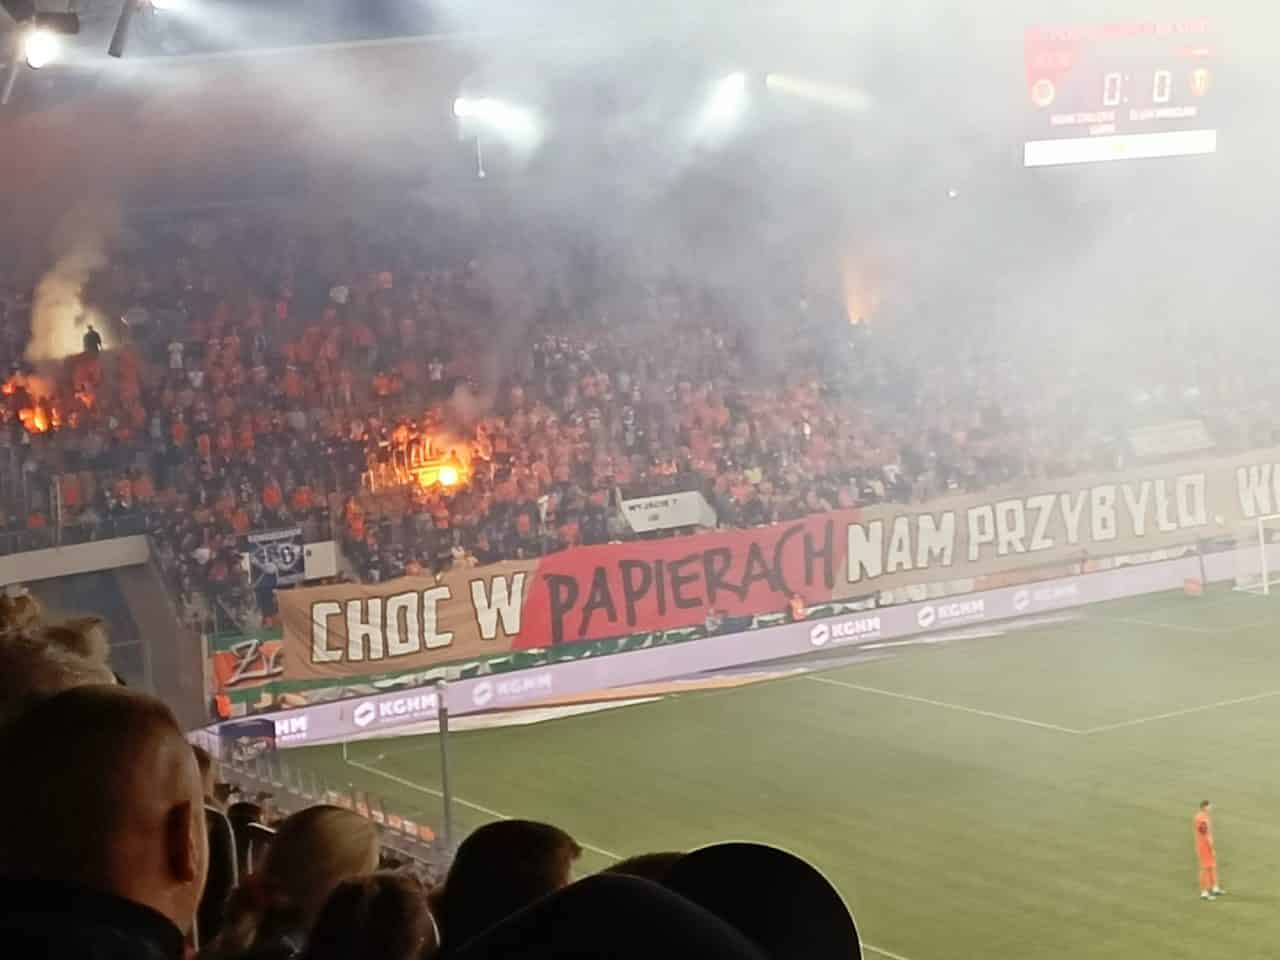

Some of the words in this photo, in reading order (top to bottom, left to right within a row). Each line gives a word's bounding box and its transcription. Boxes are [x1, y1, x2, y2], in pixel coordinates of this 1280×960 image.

[311, 573, 453, 664] CHOĆ
[471, 573, 526, 639] W
[545, 520, 835, 641] PAPIERACH
[847, 511, 956, 582] NAM
[831, 617, 880, 638] KGHM
[496, 674, 553, 695] KGHM
[380, 693, 438, 715] KGHM
[275, 716, 308, 735] HM
